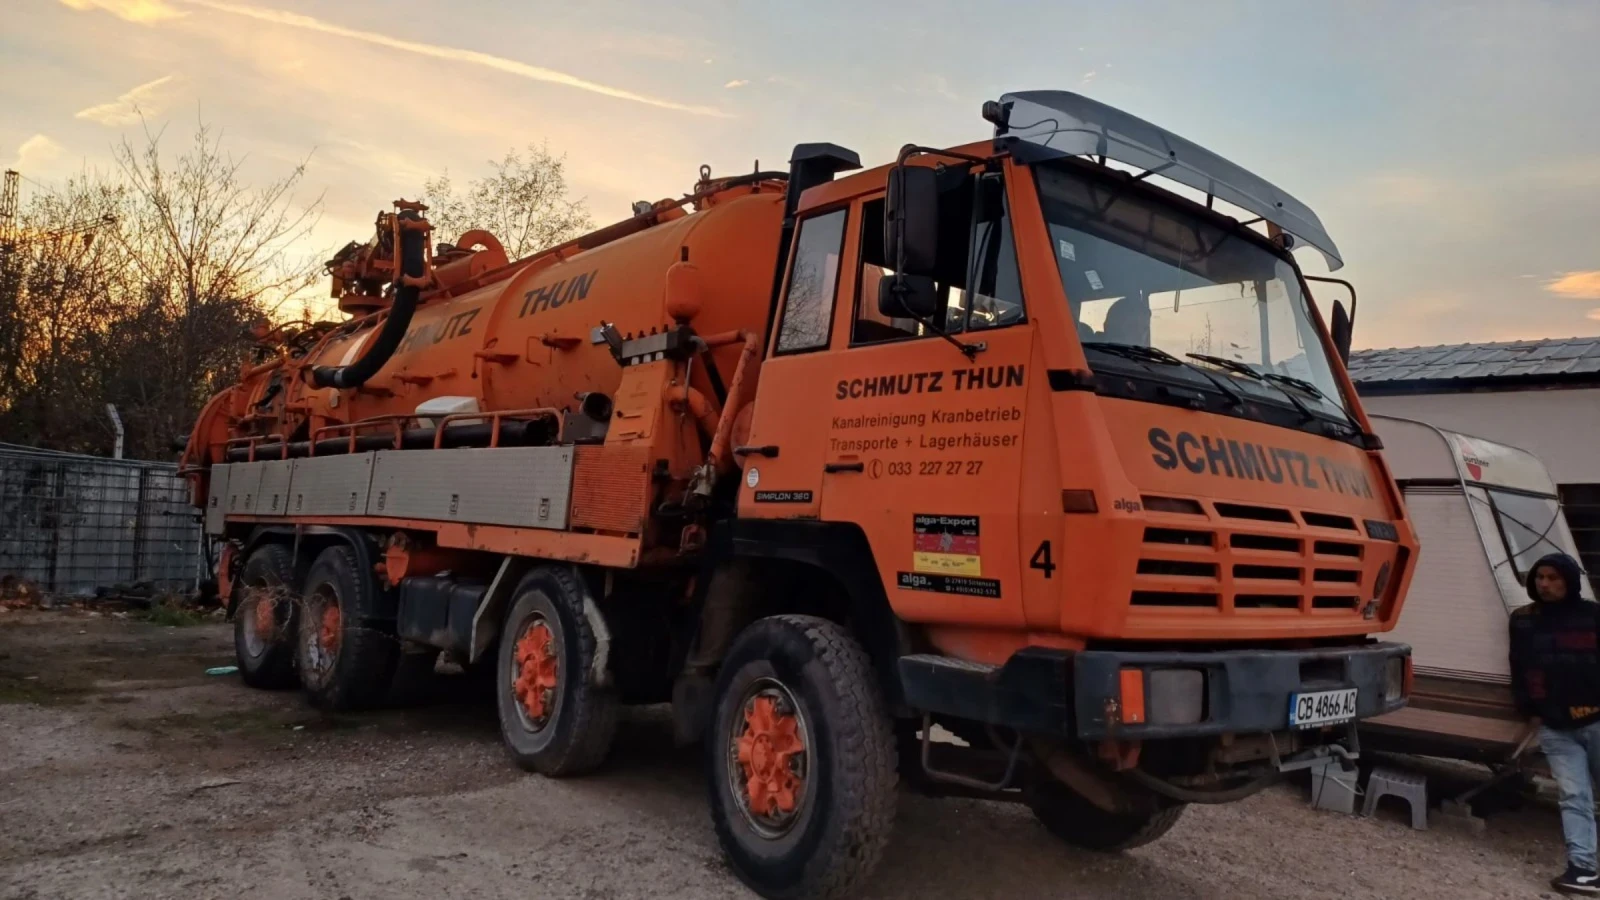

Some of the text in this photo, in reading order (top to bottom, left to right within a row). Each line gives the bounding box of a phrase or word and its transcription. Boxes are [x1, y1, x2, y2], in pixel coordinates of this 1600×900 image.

[518, 269, 598, 318] THUN
[836, 364, 1024, 400] SCHMUTZ THUN
[832, 406, 1021, 429] Kanalreinigung Kranbetrieb
[830, 432, 1018, 452] Transporte + Lagerhäuser
[888, 460, 983, 475] 033 227 27 27
[1148, 428, 1317, 489] SCHMUTZ
[756, 492, 791, 500] SIMPLON
[1114, 498, 1140, 513] alga
[915, 516, 976, 526] alga-Export
[1030, 540, 1056, 578] 4
[1298, 691, 1355, 720] CB 4866 AC
